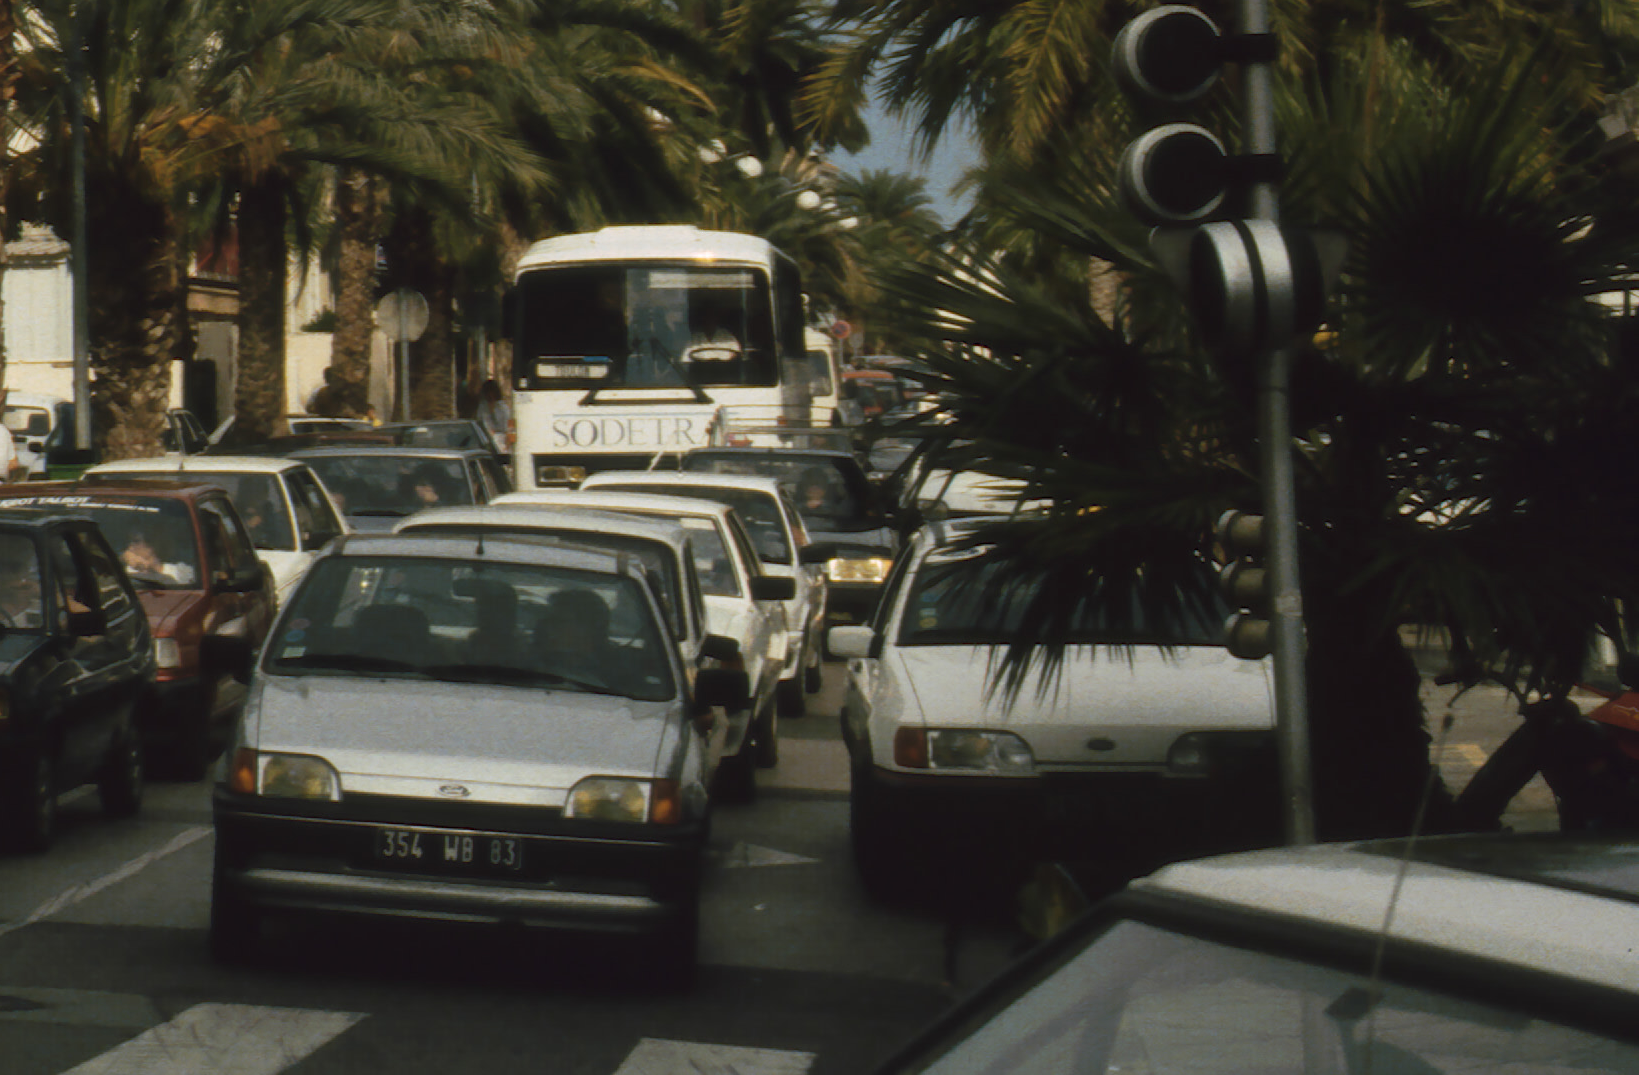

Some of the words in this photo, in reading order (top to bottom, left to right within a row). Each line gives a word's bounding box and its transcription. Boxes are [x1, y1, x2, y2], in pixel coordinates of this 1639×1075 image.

[552, 417, 708, 448] SODETR
[382, 831, 424, 858] 354
[444, 835, 474, 863] WB
[490, 839, 516, 866] 83
